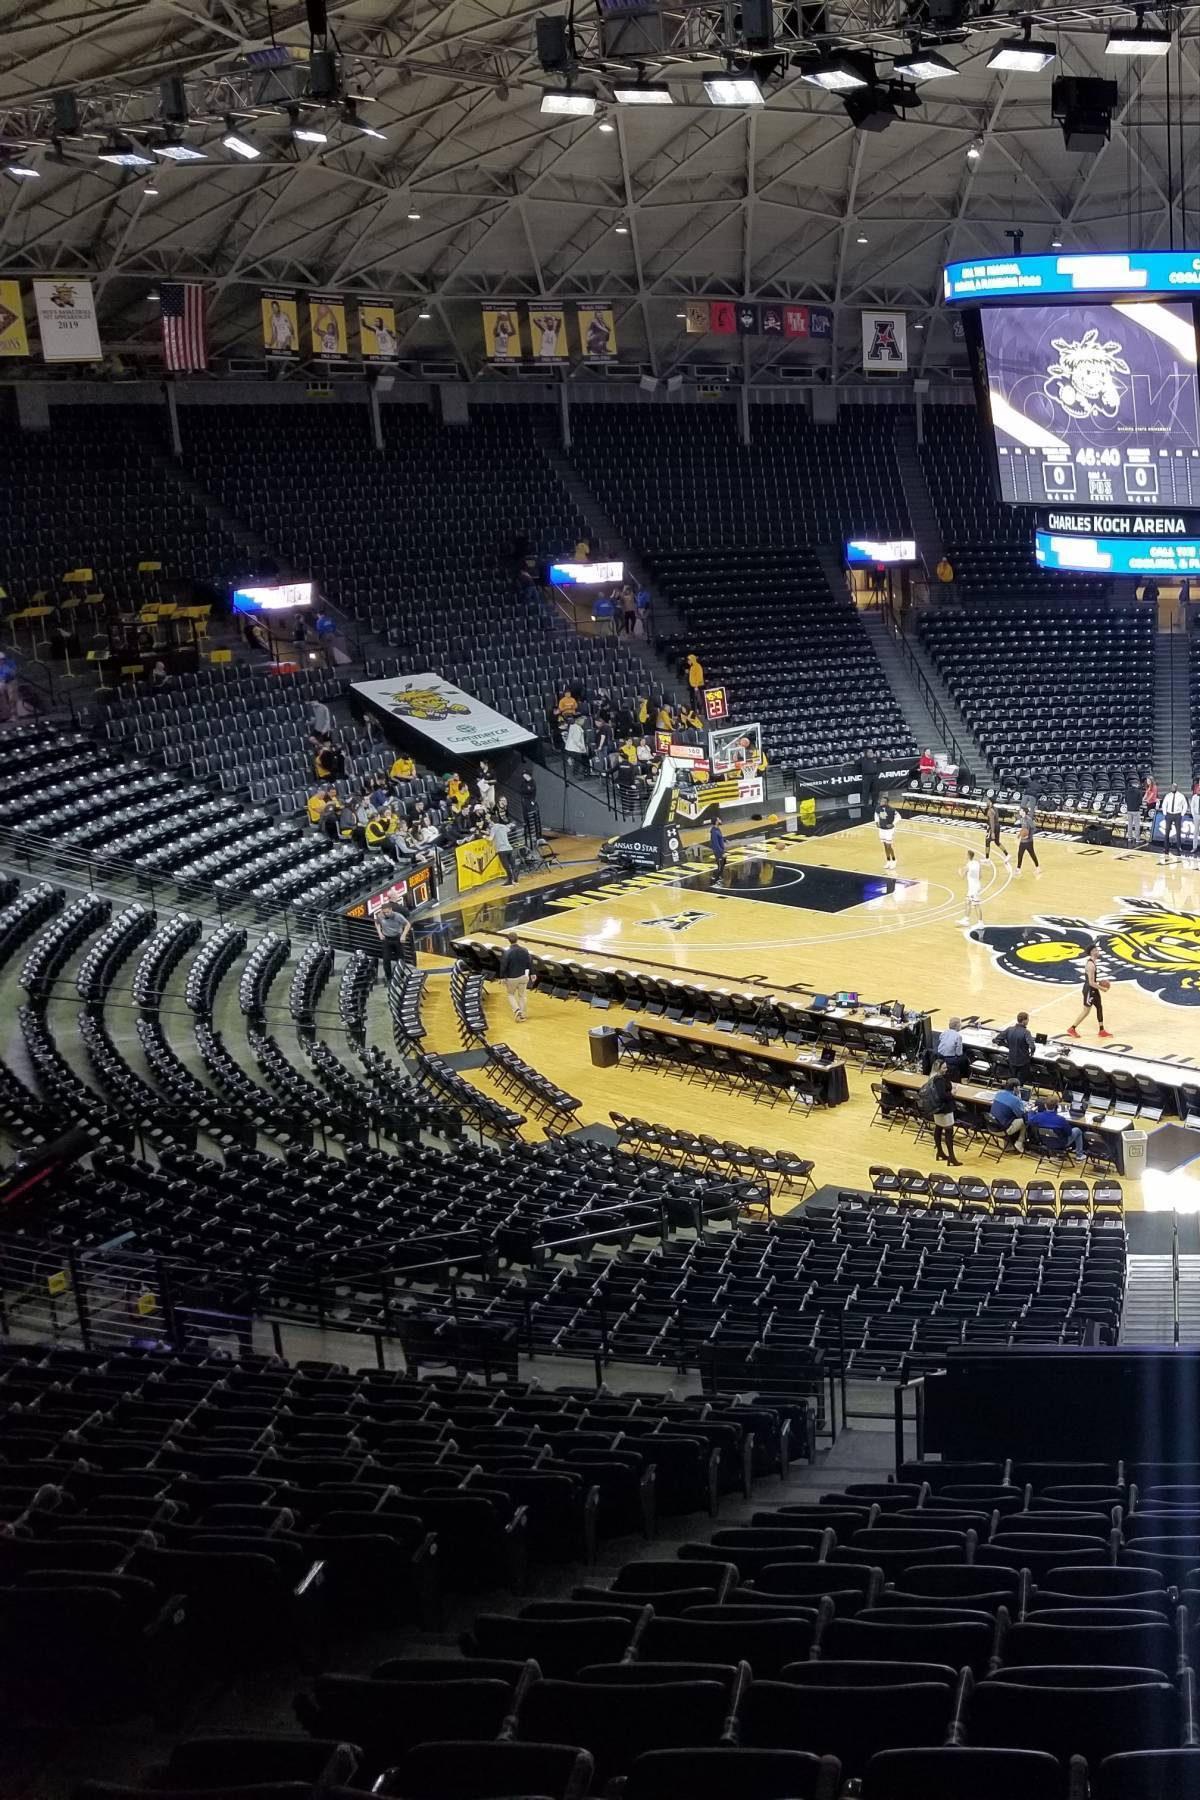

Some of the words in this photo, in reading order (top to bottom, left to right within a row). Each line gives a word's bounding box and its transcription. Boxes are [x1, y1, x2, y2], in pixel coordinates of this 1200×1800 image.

[58, 320, 79, 329] 2019
[1075, 447, 1120, 467] 45:40
[1048, 513, 1091, 531] CHARLES
[1094, 515, 1130, 533] KOCH
[1132, 516, 1186, 534] ARENA
[709, 700, 723, 716] 23
[447, 727, 510, 743] Commerce
[471, 736, 504, 747] Bank
[642, 844, 659, 853] STAR
